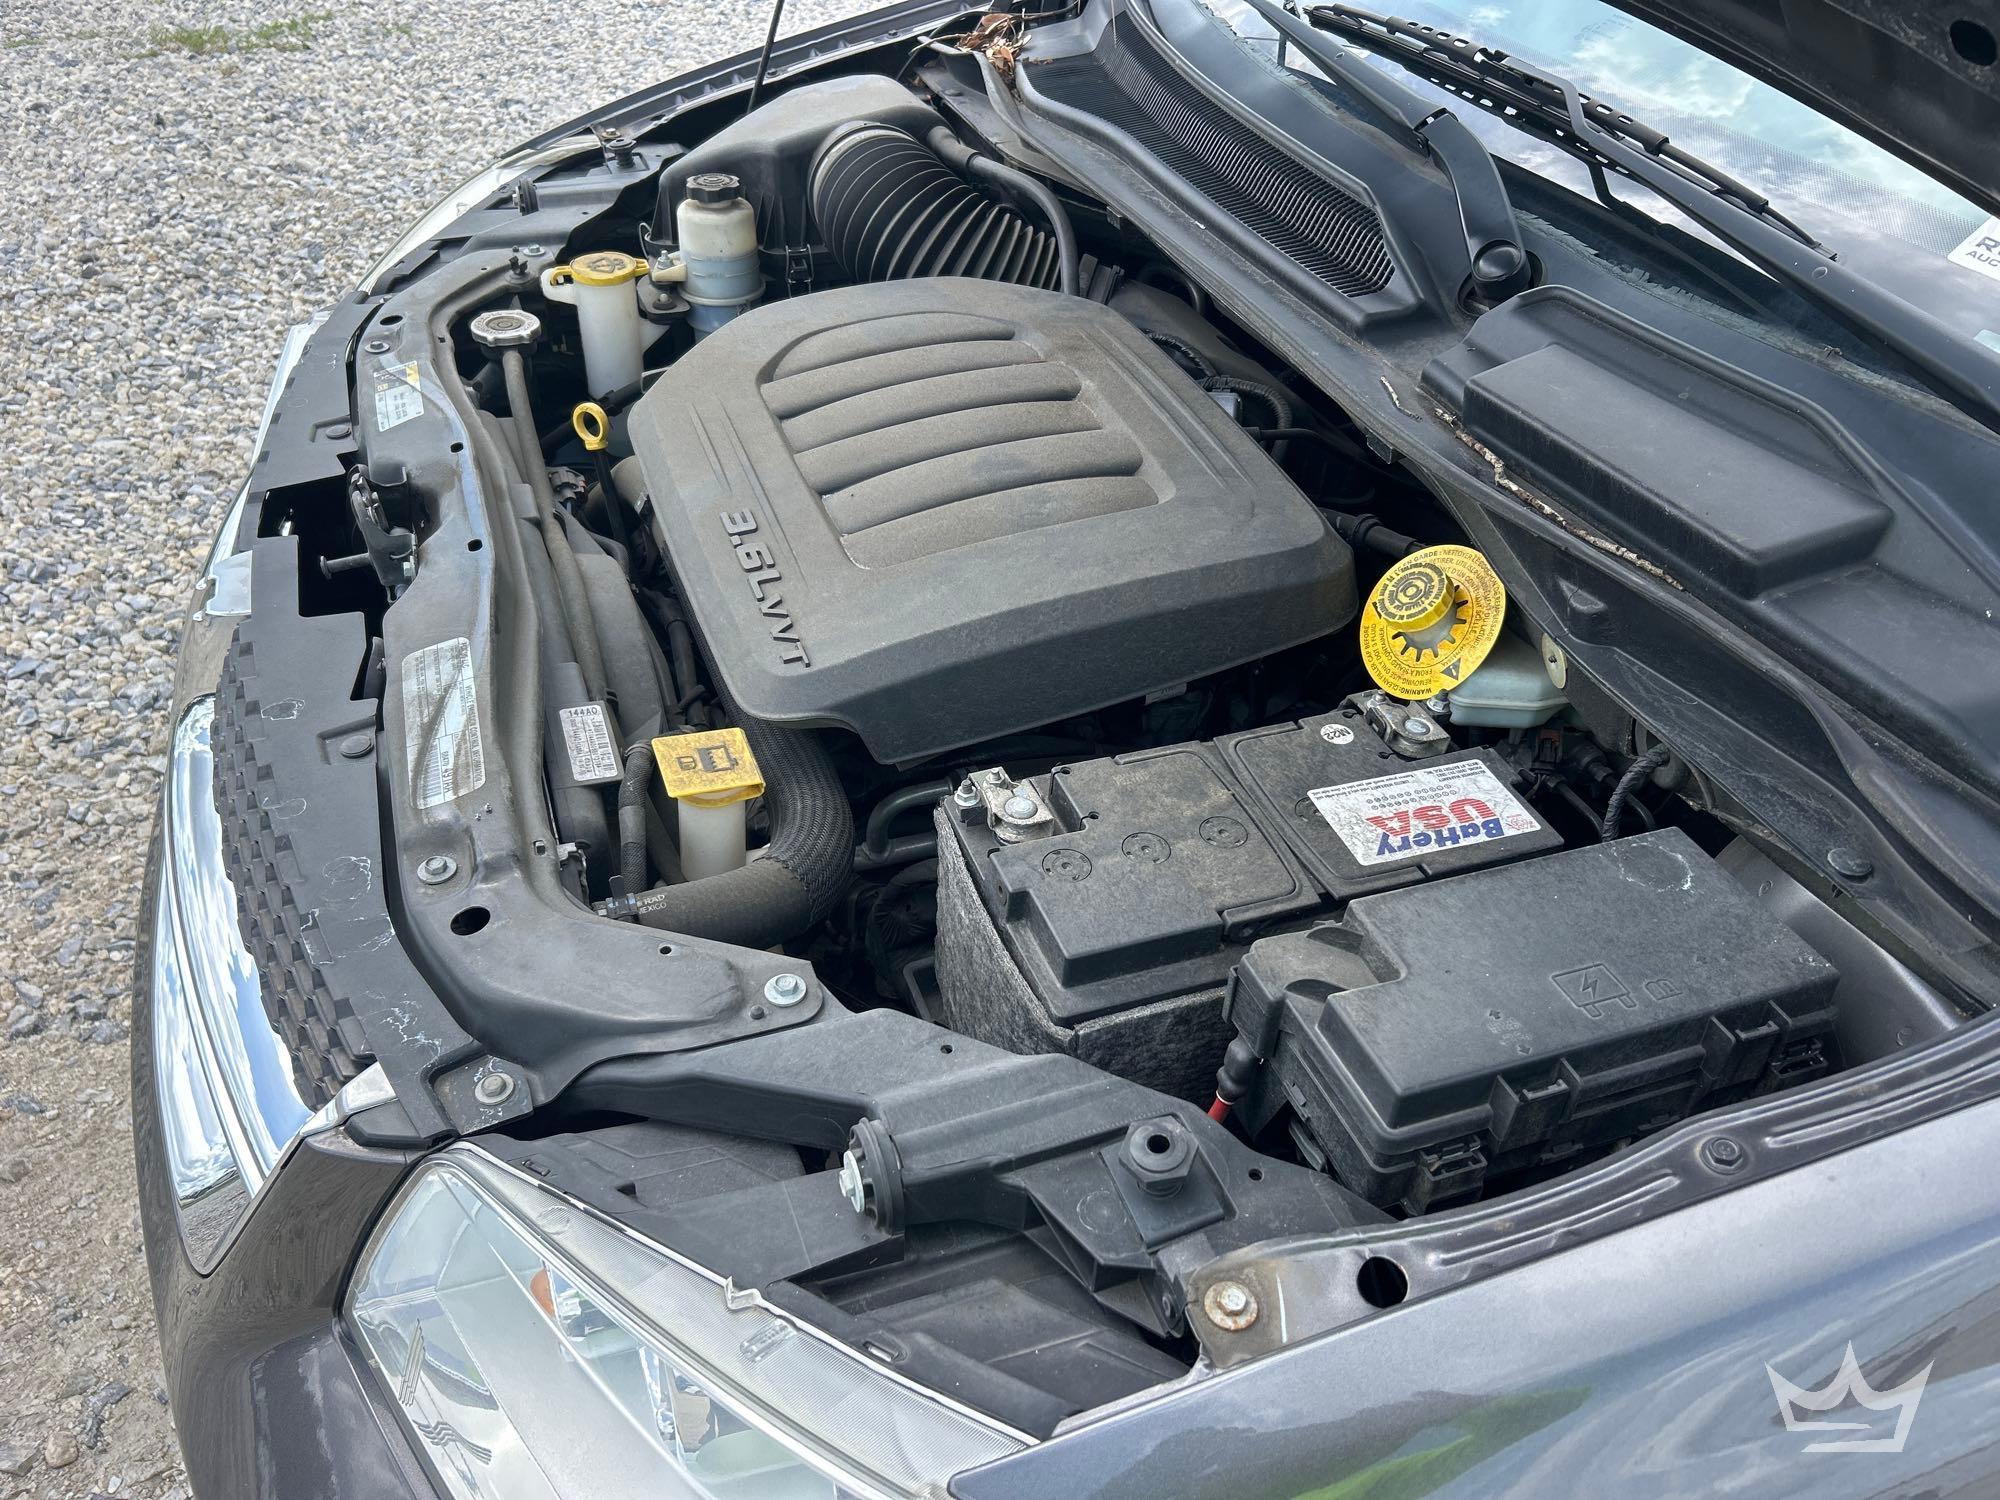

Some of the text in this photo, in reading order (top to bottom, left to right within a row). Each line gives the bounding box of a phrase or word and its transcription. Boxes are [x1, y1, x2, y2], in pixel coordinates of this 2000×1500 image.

[1976, 235, 2000, 253] R
[1363, 625, 1432, 695] WARNING: CLEAN FILLER CAP BEFORE
[1373, 648, 1382, 662] DOT
[1378, 660, 1392, 676] ONLY
[1414, 668, 1432, 676] FROM
[465, 685, 474, 704] VEHICLE
[470, 727, 480, 749] CONTROL
[1323, 728, 1351, 741] M22
[472, 749, 482, 783] INFORMATION
[1365, 798, 1494, 837] USA
[1376, 817, 1505, 856] Battery
